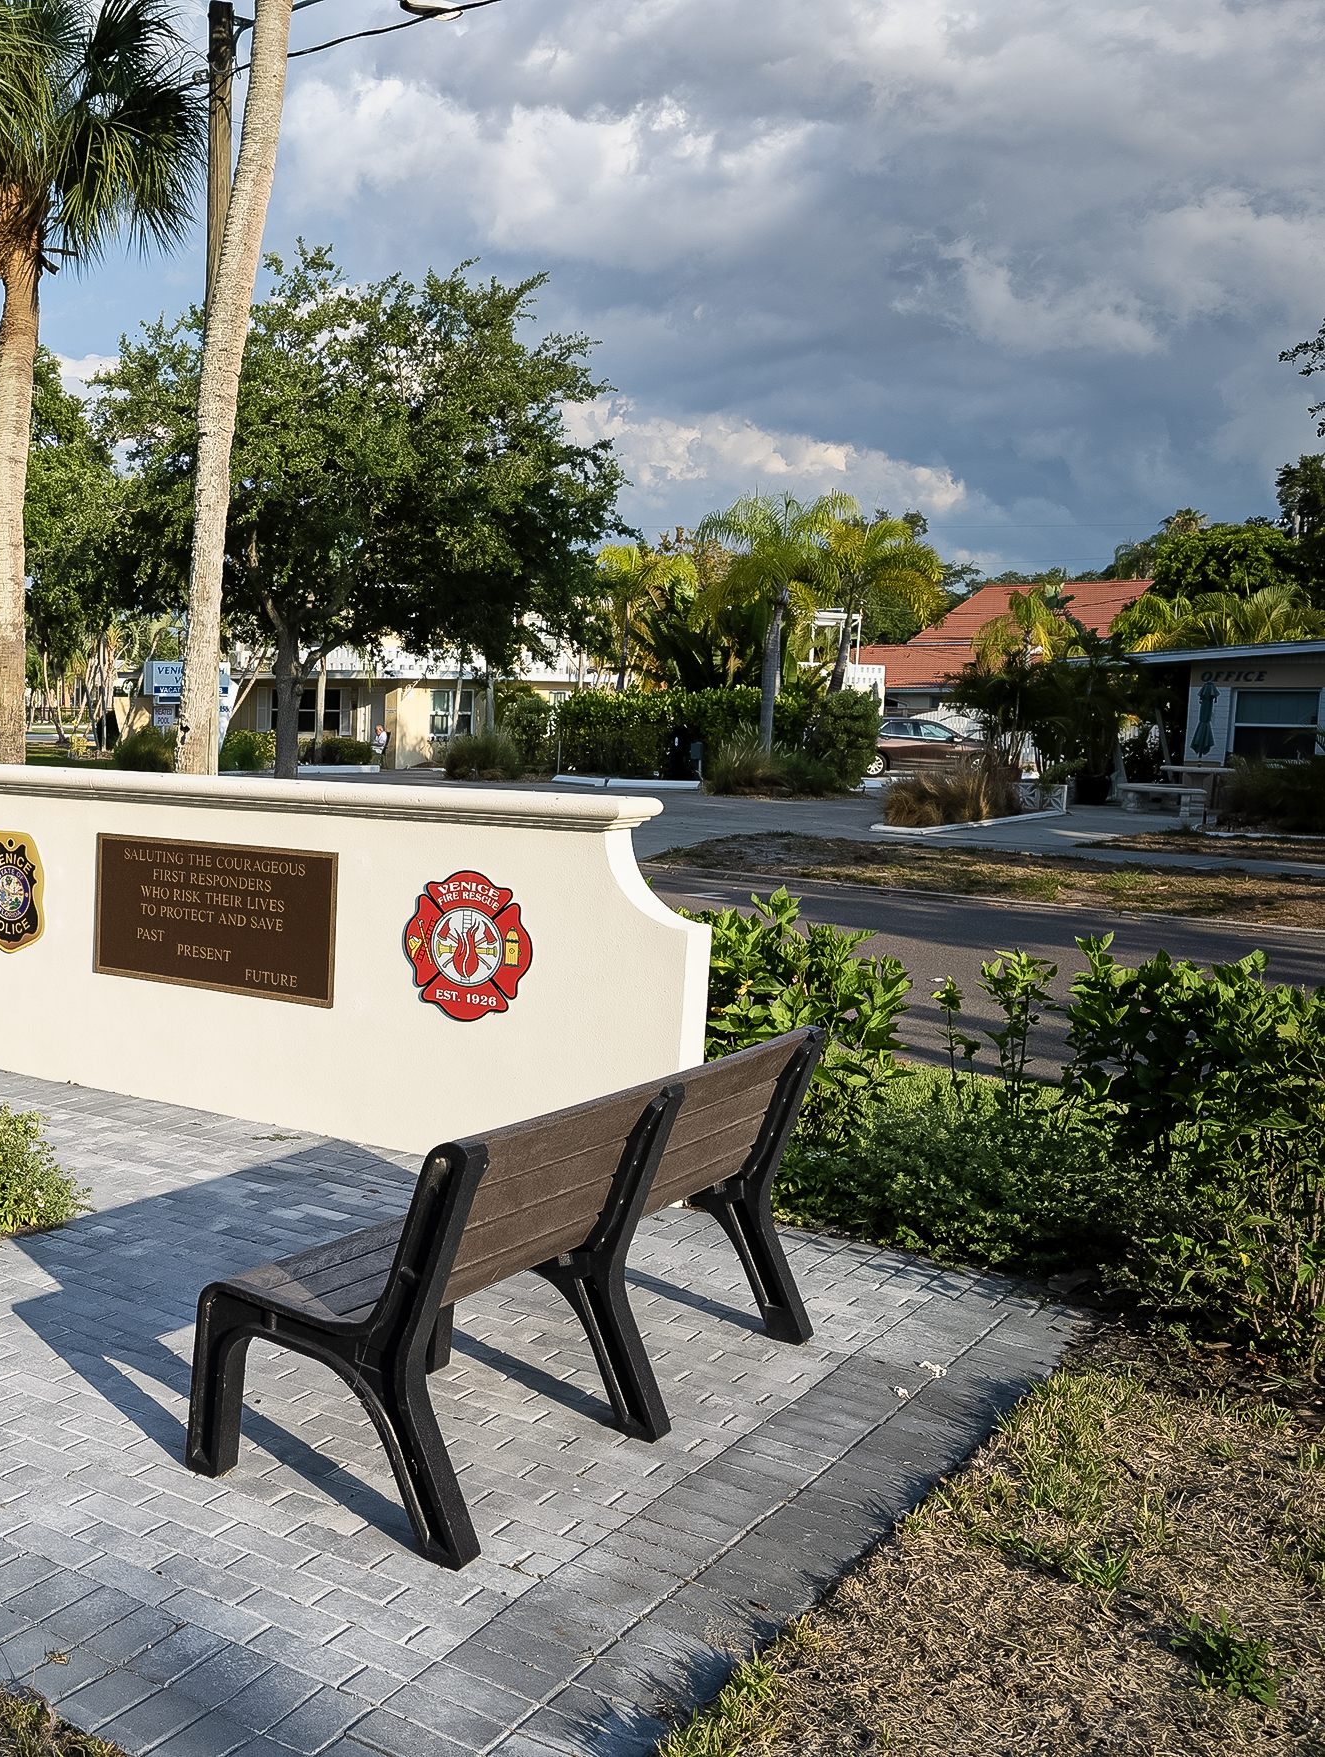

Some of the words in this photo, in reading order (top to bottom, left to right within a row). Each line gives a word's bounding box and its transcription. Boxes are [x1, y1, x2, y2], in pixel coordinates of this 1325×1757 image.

[1200, 670, 1268, 682] OFFICE
[157, 716, 170, 724] POOL
[124, 848, 184, 865] SALUTING
[188, 854, 212, 868] THE
[216, 856, 306, 876] COURAGEOUS
[16, 871, 24, 880] OF
[153, 869, 186, 883] FIRST
[190, 873, 271, 893] RESPONDERS
[141, 885, 169, 900] WHO
[173, 889, 201, 904] RISK
[205, 893, 242, 908] THEIR
[247, 898, 285, 912] LIVES
[438, 882, 500, 900] VENICE
[437, 892, 459, 906] FIRE
[463, 892, 500, 911] RESCUE
[141, 903, 156, 916] TO
[160, 906, 214, 923] PROTECT
[218, 914, 246, 927] AND
[250, 916, 283, 932] SAVE
[137, 927, 165, 942] PAST
[177, 944, 231, 962] PRESENT
[245, 969, 298, 987] FUTURE
[435, 989, 461, 1002] EST.
[466, 993, 497, 1007] 1926
